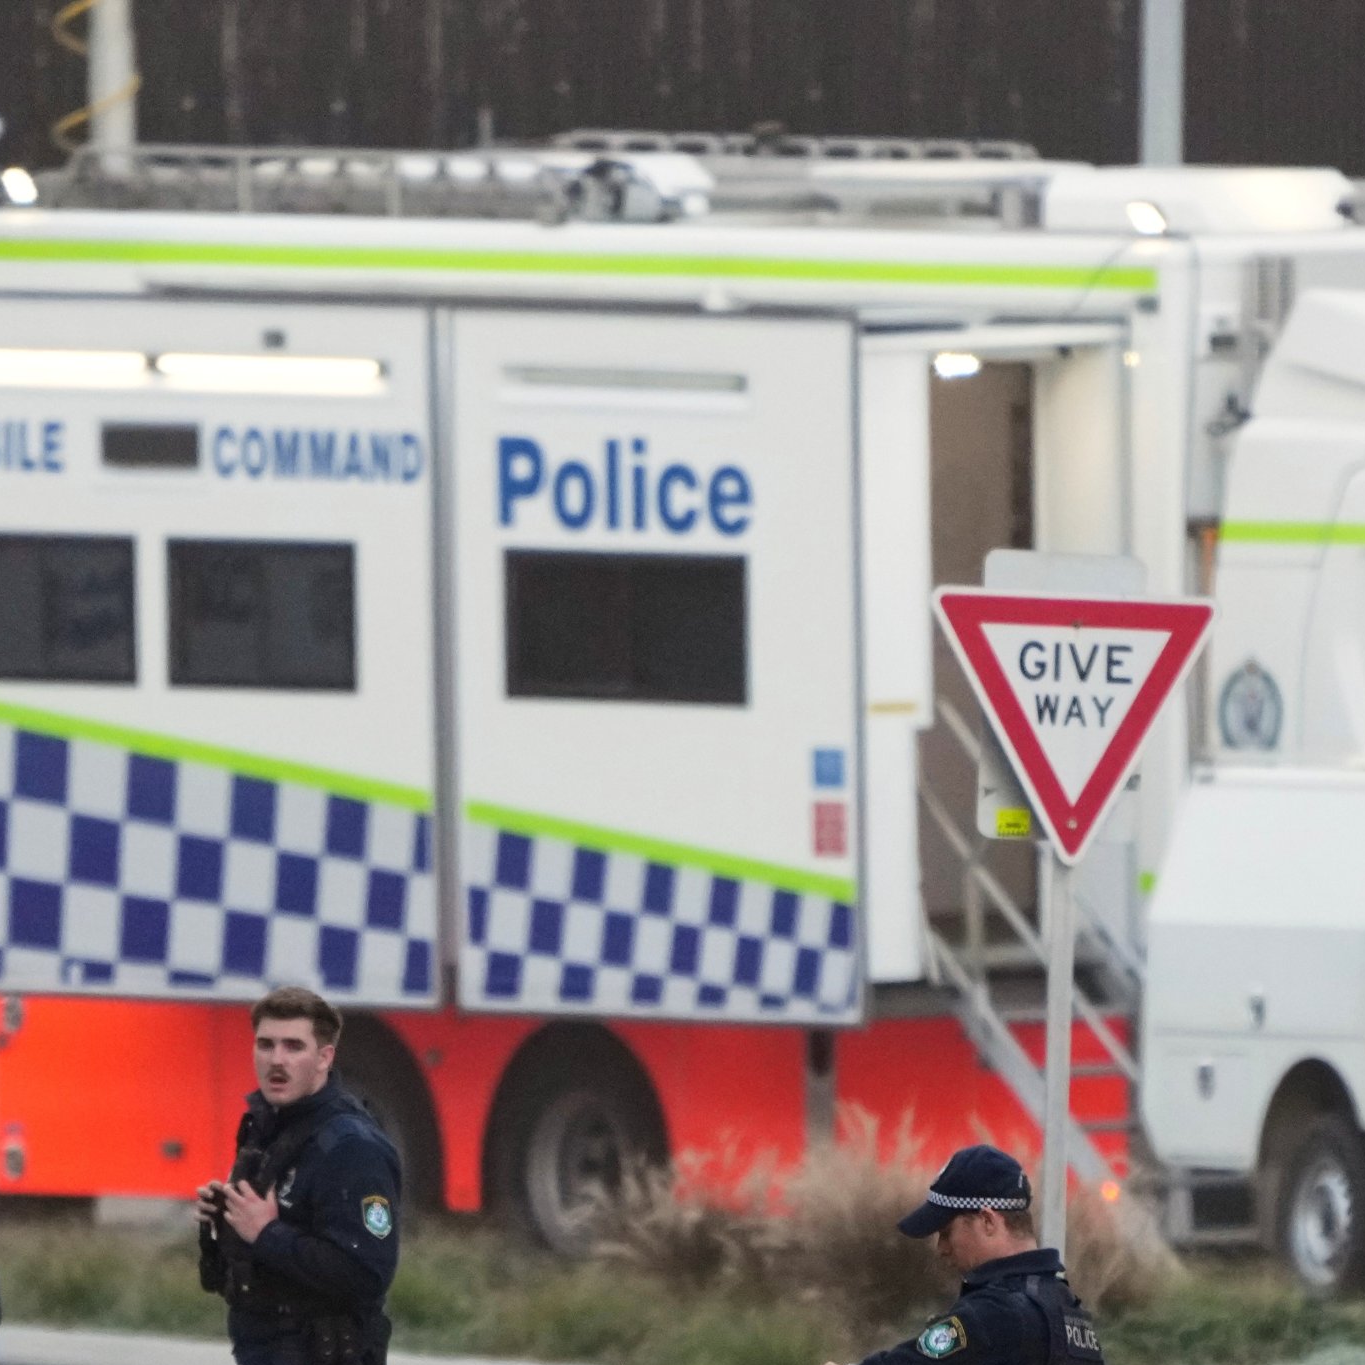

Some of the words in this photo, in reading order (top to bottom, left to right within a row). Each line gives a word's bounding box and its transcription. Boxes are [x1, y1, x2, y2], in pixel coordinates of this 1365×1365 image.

[211, 426, 426, 484] COMMAND
[498, 436, 753, 536] Police
[1019, 640, 1134, 685] GIVE
[1035, 694, 1114, 727] WAY
[1065, 1324, 1100, 1351] POLICE
